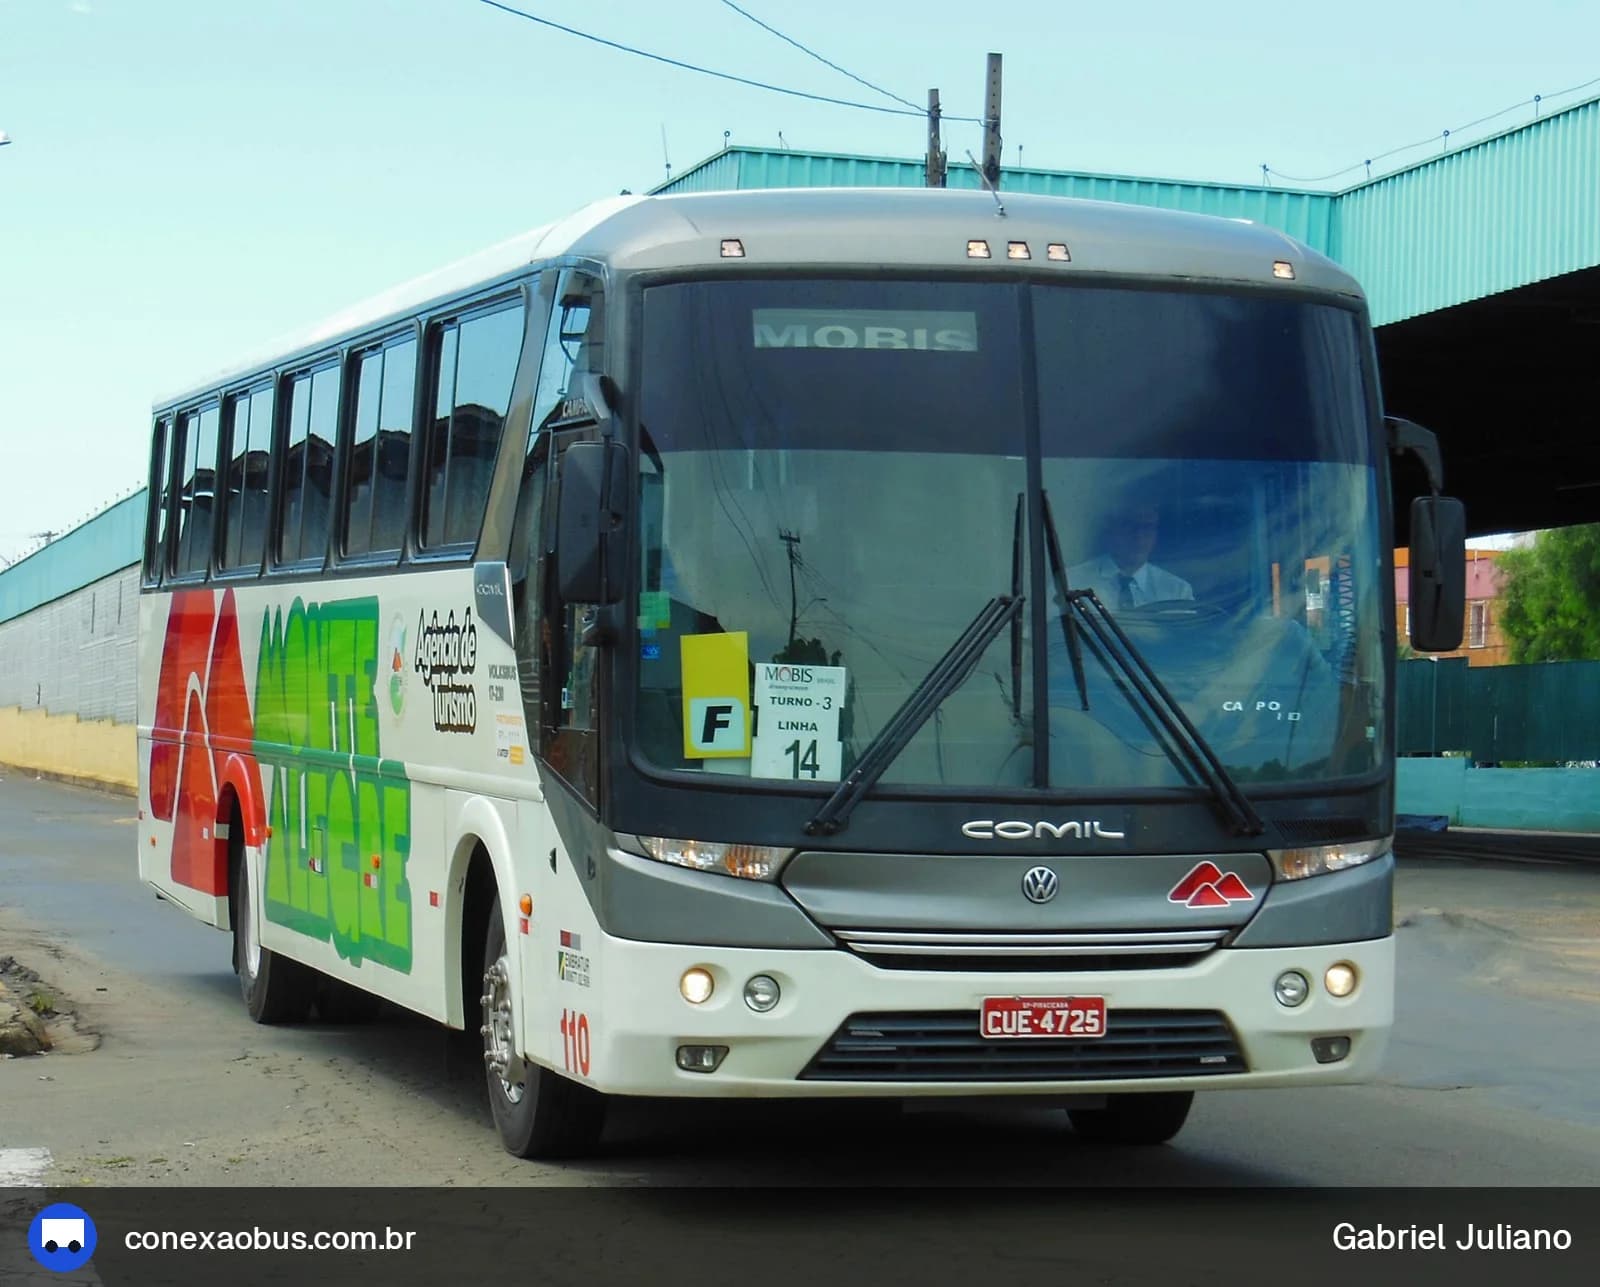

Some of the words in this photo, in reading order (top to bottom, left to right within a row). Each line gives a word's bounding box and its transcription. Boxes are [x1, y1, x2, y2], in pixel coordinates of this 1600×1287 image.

[754, 324, 978, 351] MOBIS
[460, 606, 477, 674] de
[252, 596, 379, 757] MONTE
[764, 666, 813, 683] MOBIS
[431, 674, 477, 734] Turismo
[770, 696, 813, 707] TURNO
[822, 696, 832, 710] 3
[701, 706, 733, 743] F
[778, 721, 818, 732] LINHA
[784, 739, 820, 779] 14
[961, 820, 1125, 839] COMIL
[264, 763, 412, 975] ALEGRE
[560, 1008, 590, 1076] 110
